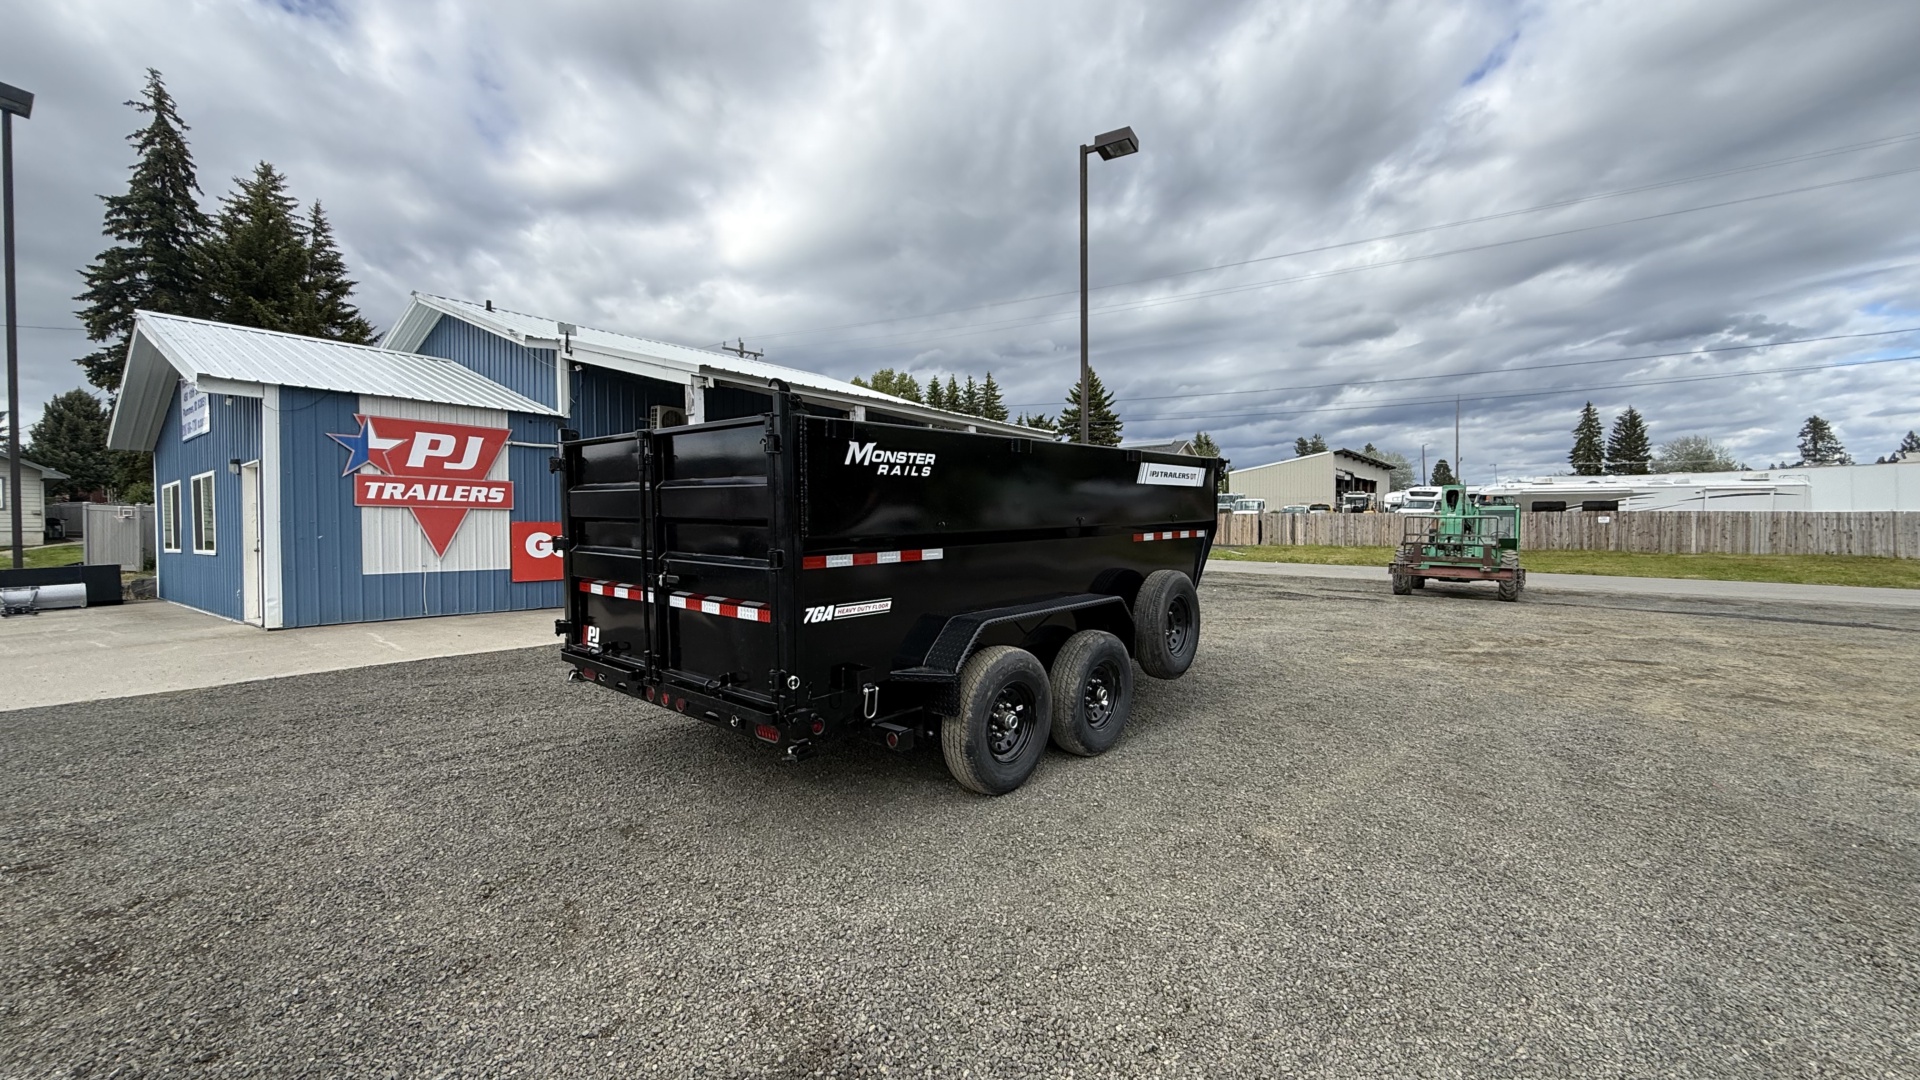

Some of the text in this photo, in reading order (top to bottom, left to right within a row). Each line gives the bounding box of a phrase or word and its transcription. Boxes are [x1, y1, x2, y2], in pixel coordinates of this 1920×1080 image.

[405, 431, 484, 470] PJ
[844, 440, 936, 466] MONSTER
[876, 464, 932, 477] RAILS
[1151, 470, 1160, 478] PJ
[1160, 471, 1190, 480] TRAILERS
[364, 481, 506, 503] TRAILERS
[525, 531, 563, 559] G
[803, 602, 889, 624] 7GA HEAVY DUTY FLOOR
[587, 625, 600, 643] PJ
